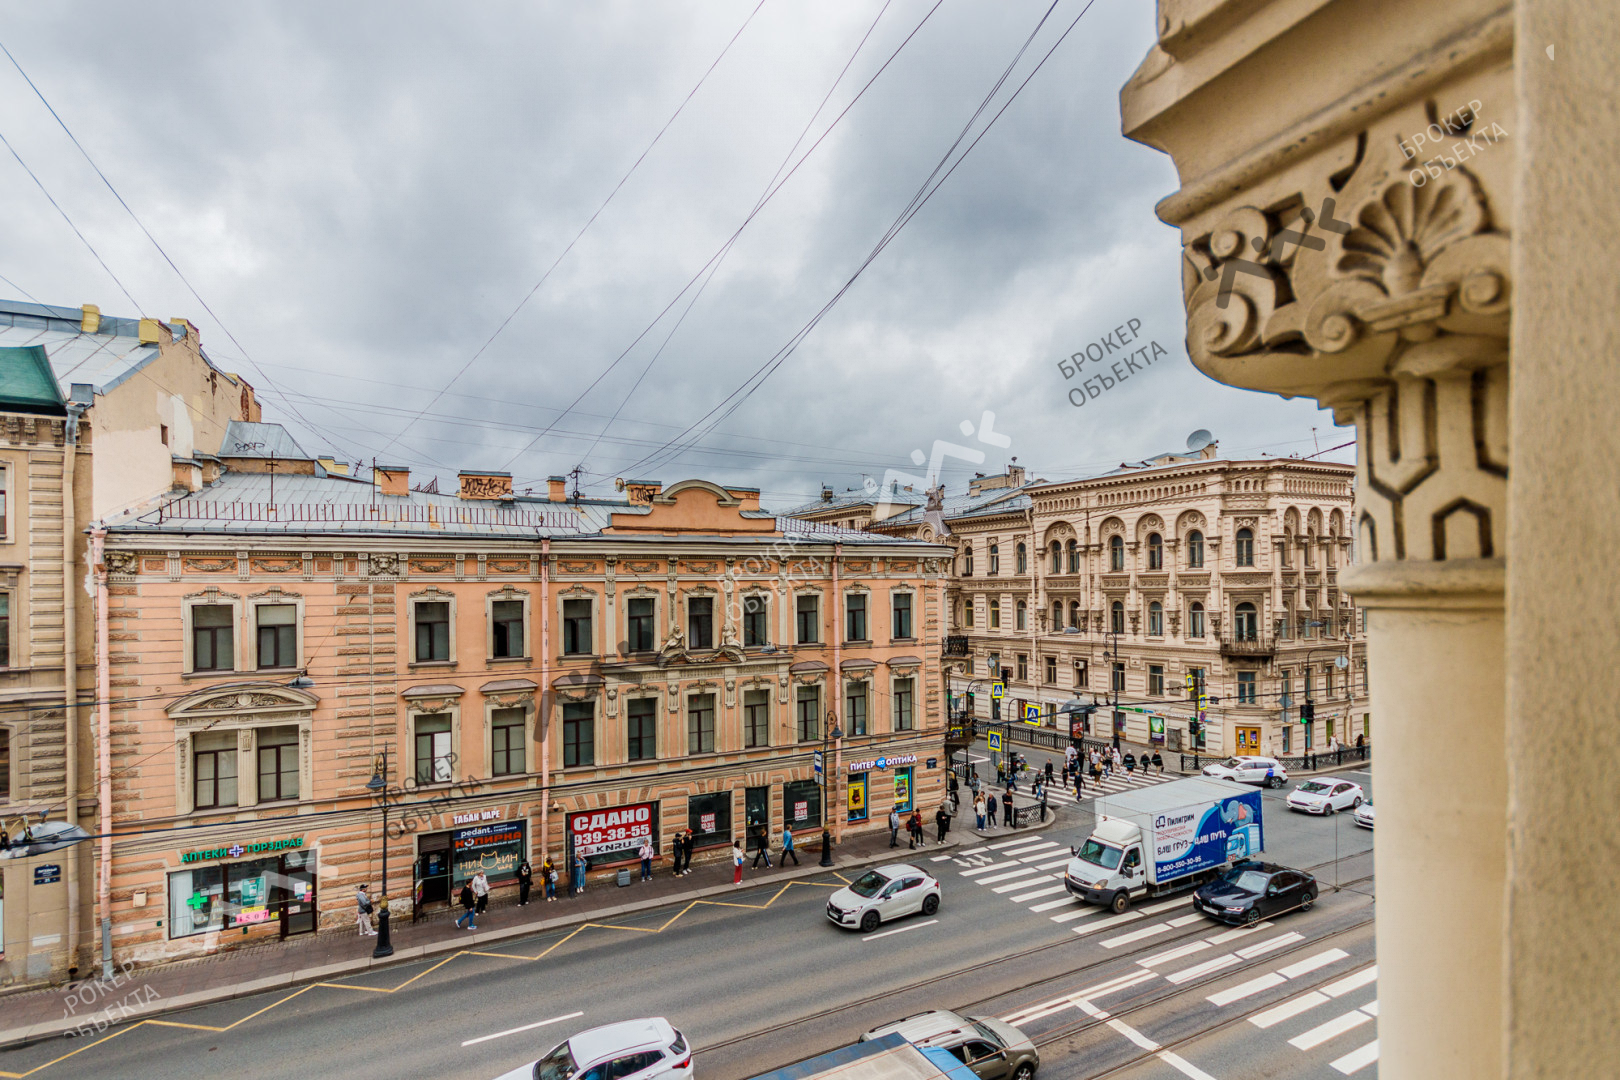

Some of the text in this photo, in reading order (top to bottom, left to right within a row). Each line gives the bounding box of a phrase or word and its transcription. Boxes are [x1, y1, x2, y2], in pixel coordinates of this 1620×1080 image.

[850, 755, 918, 771] ПИТЕР ОПТИКА
[481, 810, 500, 820] VAPE
[573, 807, 649, 831] СДАНО
[574, 824, 650, 846] 939-38-55
[1157, 844, 1171, 856] ВАШ
[1173, 839, 1188, 851] ГРУЗ
[1194, 834, 1209, 845] НАШ
[1210, 829, 1227, 842] ПУТЬ
[181, 838, 304, 863] АПТЕКИ ГОРЗДРАВ
